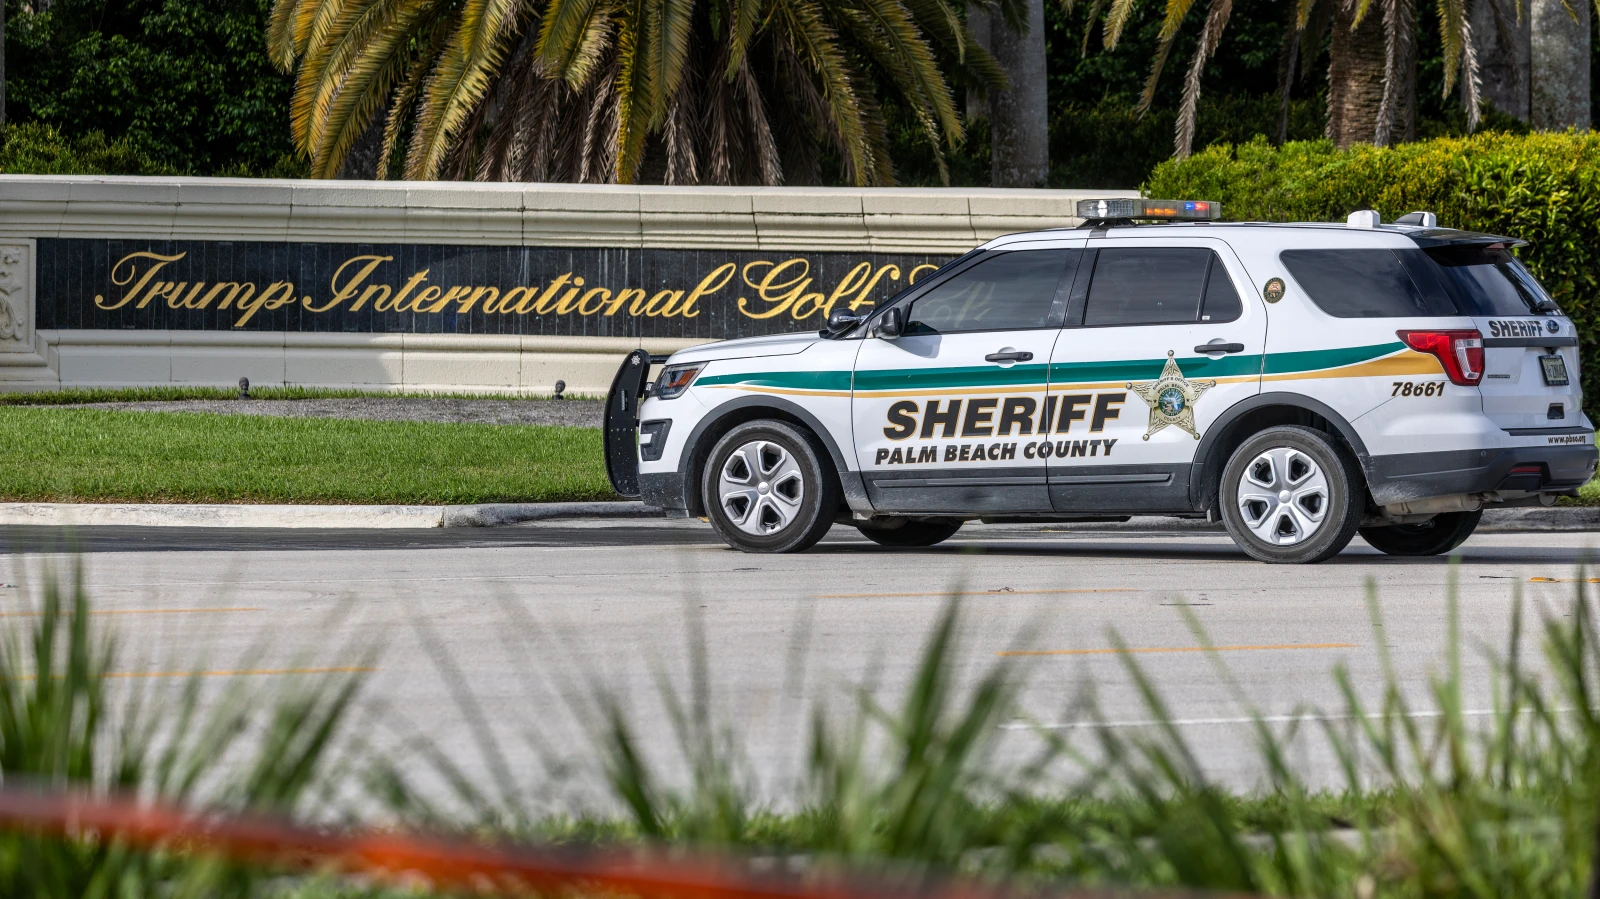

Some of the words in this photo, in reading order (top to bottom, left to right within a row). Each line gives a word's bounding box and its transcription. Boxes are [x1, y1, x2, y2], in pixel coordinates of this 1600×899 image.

[95, 251, 297, 327] Trump
[303, 255, 736, 318] International
[738, 258, 900, 320] Golf
[1489, 320, 1543, 337] SHERIFF
[1391, 381, 1446, 397] 78661
[883, 393, 1127, 442] SHERIFF
[1547, 434, 1586, 445] www.pbso.org
[875, 446, 938, 465] PALM
[943, 442, 1018, 462] BEACH
[1023, 439, 1118, 459] COUNTY
